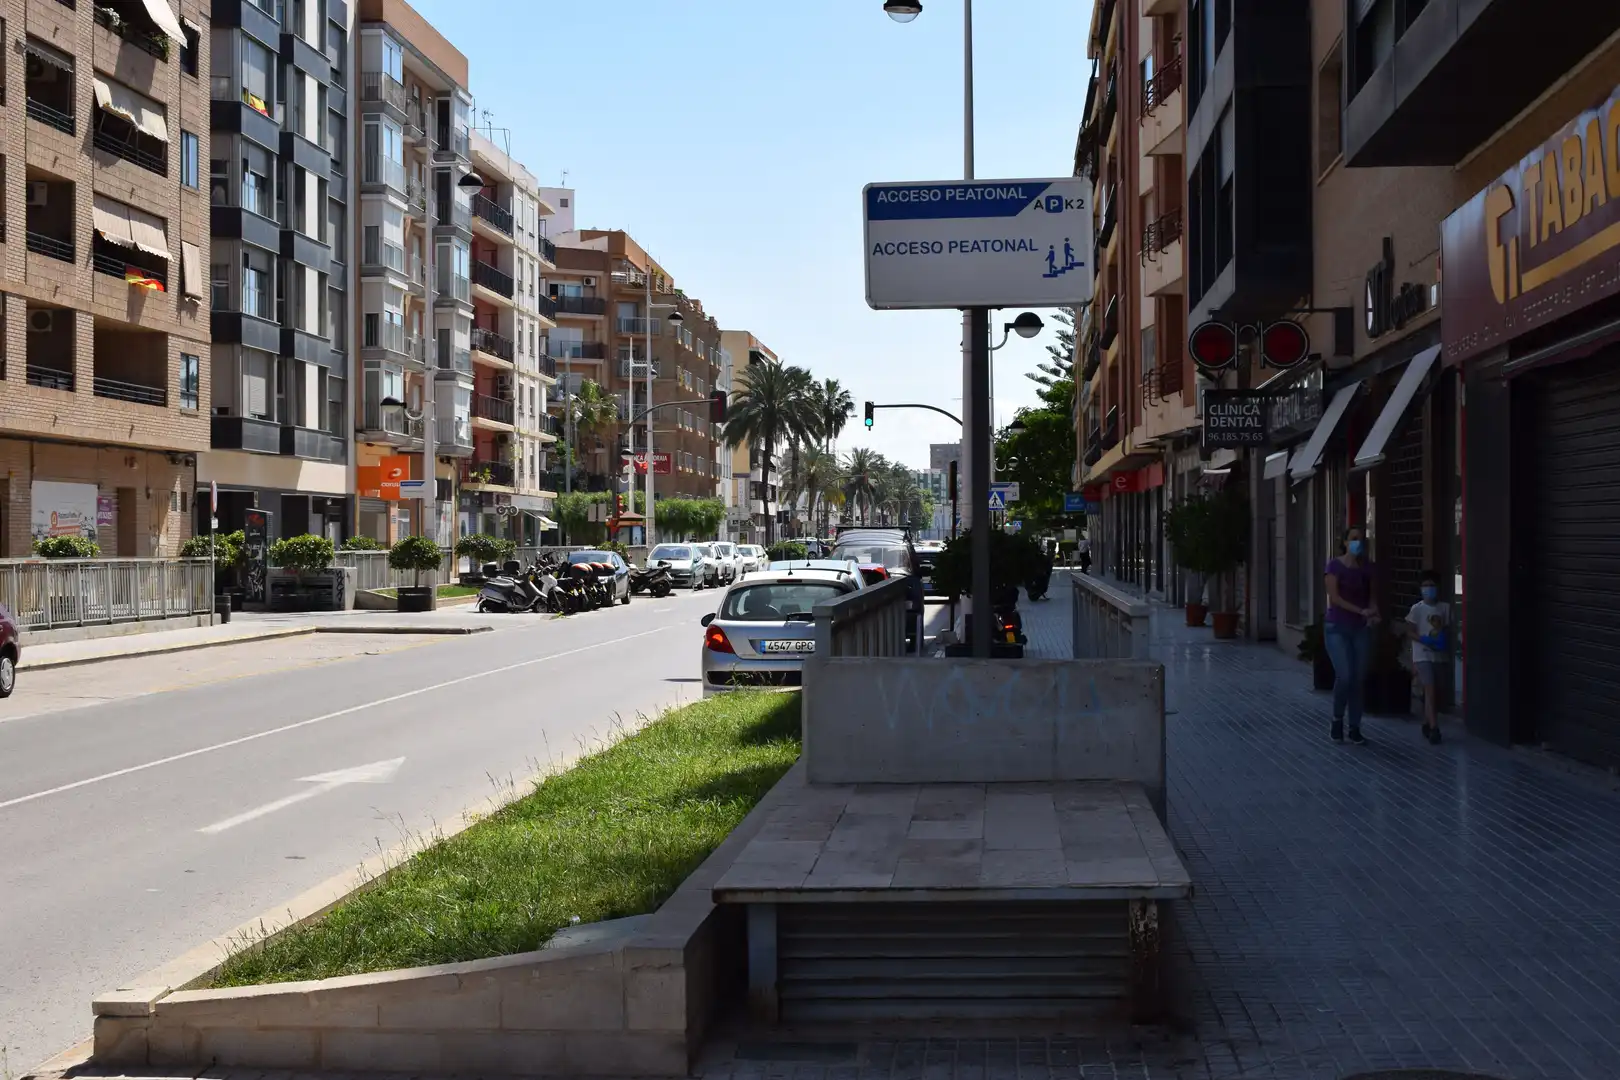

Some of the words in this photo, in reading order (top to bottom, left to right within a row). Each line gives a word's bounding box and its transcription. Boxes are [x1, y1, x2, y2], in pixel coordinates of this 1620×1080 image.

[877, 188, 941, 203] ACCESO
[945, 187, 1028, 201] PEATONAL
[872, 240, 943, 256] ACCESO
[948, 238, 1039, 254] PEATONAL
[1209, 403, 1261, 416] CLÍNICA
[1209, 416, 1262, 428] DENTAL
[768, 641, 792, 651] 4547
[795, 641, 813, 651] GPC
